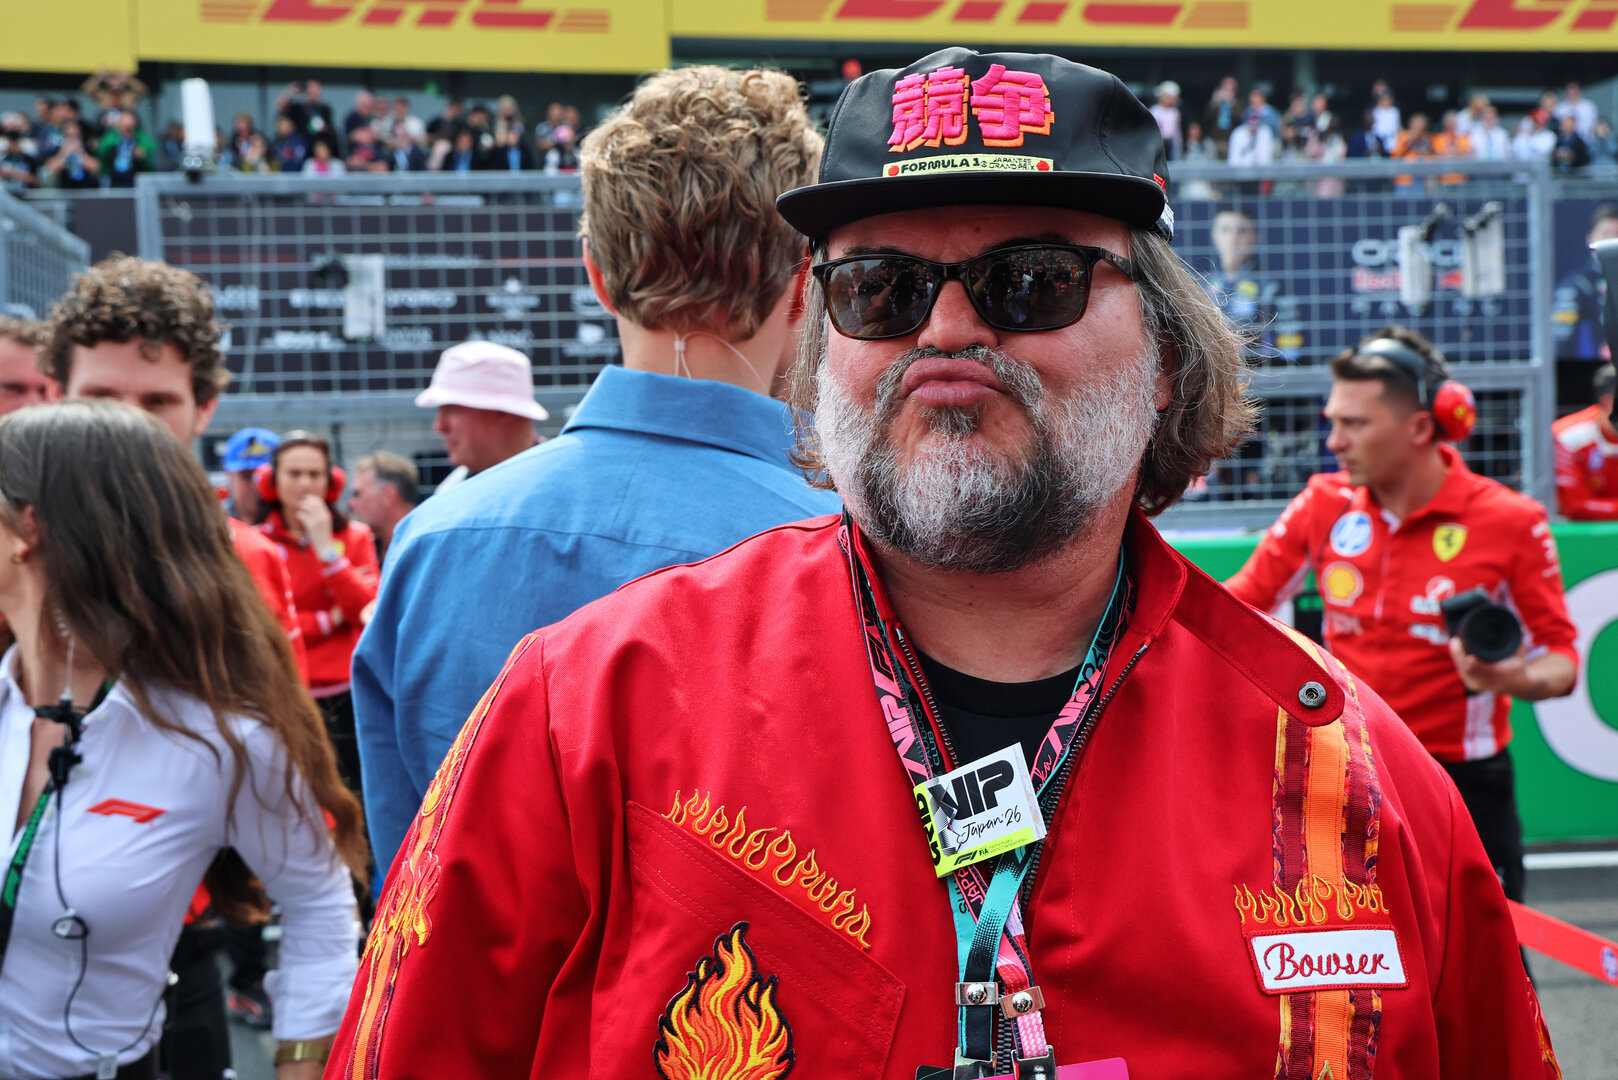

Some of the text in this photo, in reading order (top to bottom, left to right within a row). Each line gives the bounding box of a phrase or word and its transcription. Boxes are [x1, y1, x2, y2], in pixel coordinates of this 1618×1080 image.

[887, 63, 1055, 153] 競争
[900, 157, 970, 174] FORMULA
[989, 162, 1017, 170] GRAND
[992, 156, 1032, 164] JAPANESE
[928, 759, 1015, 821] VIP
[1263, 941, 1390, 980] Bowser
